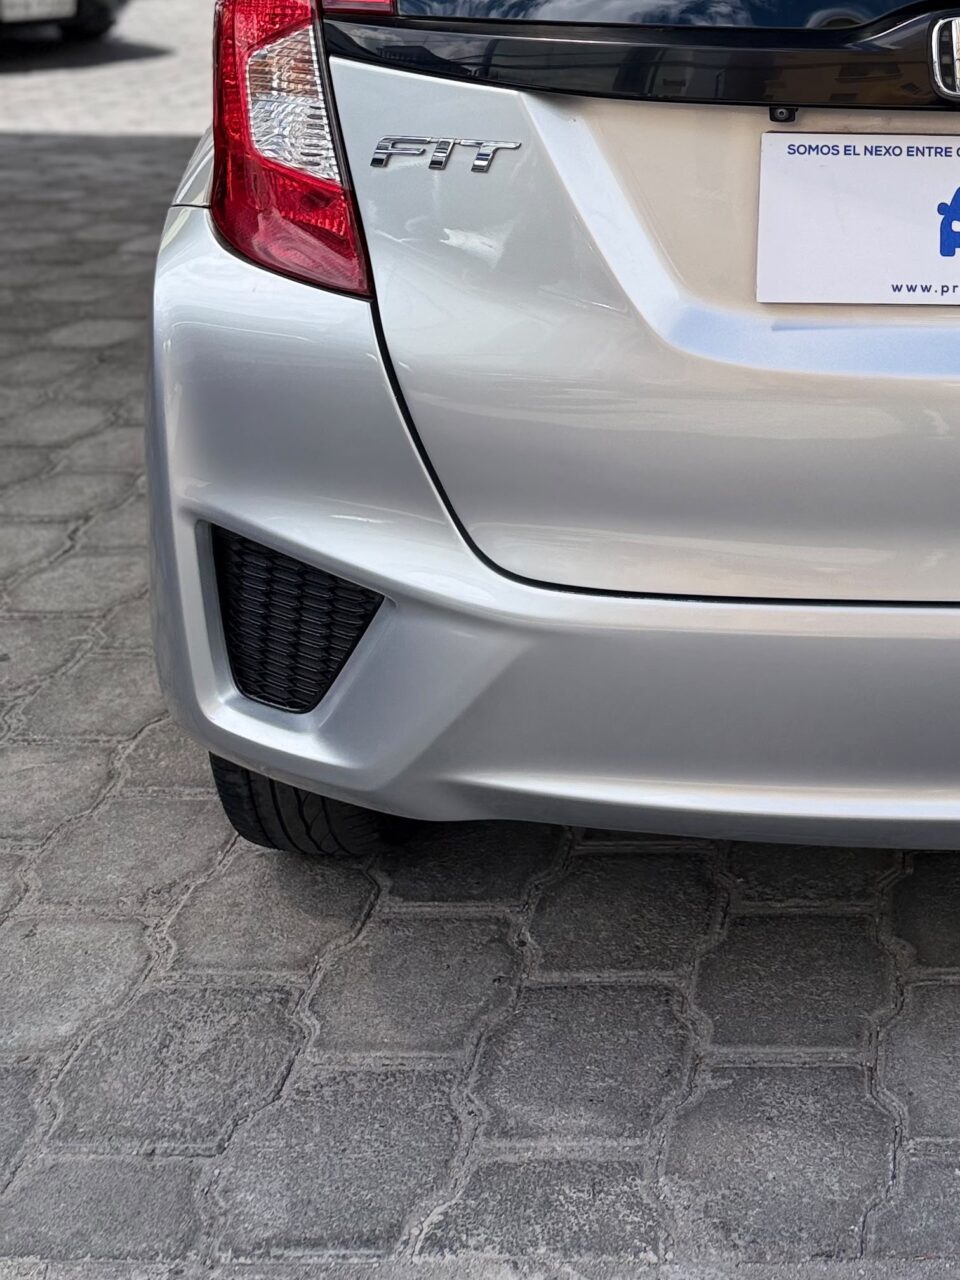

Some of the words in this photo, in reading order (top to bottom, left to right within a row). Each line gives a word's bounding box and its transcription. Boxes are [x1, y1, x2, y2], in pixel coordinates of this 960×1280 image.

[370, 135, 522, 174] FIT
[787, 144, 840, 156] SOMOS
[843, 145, 860, 156] EL
[863, 145, 903, 157] NEXO
[906, 146, 953, 158] ENTRE
